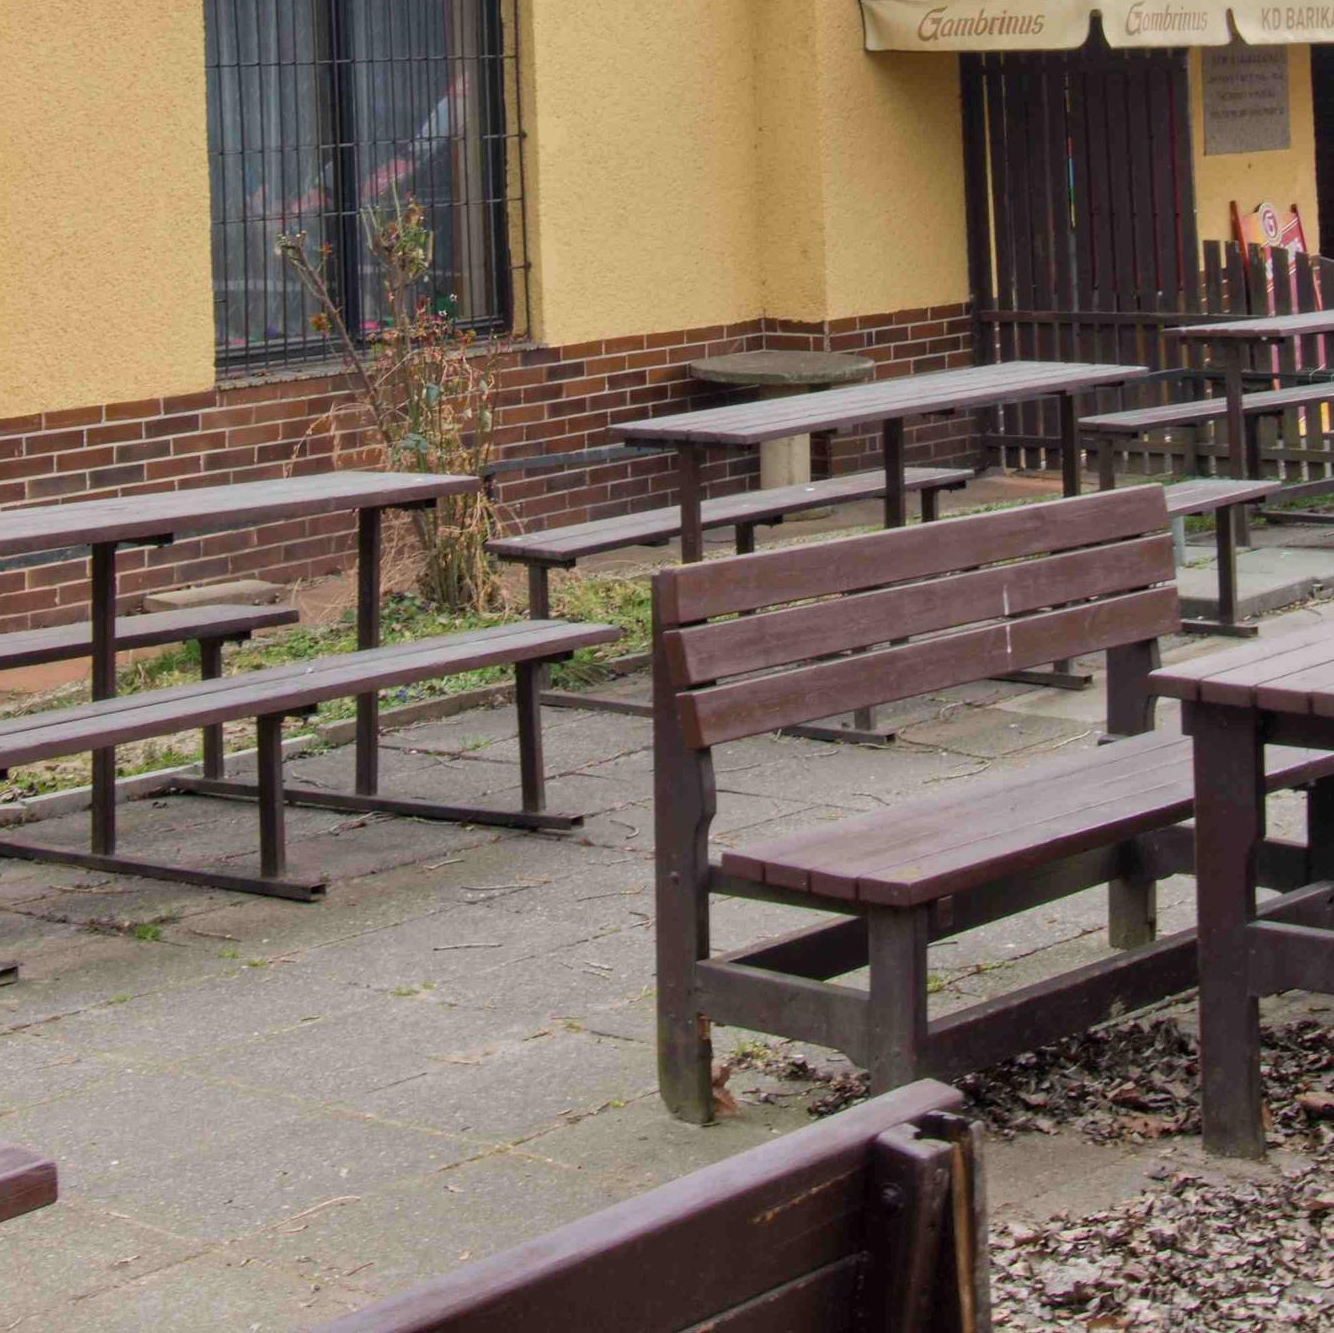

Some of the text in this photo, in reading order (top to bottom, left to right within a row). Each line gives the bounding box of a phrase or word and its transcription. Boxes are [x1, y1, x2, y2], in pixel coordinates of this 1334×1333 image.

[917, 6, 1046, 42] Gambrinus
[1125, 1, 1208, 36] Gambrinus
[1261, 7, 1281, 30] KD
